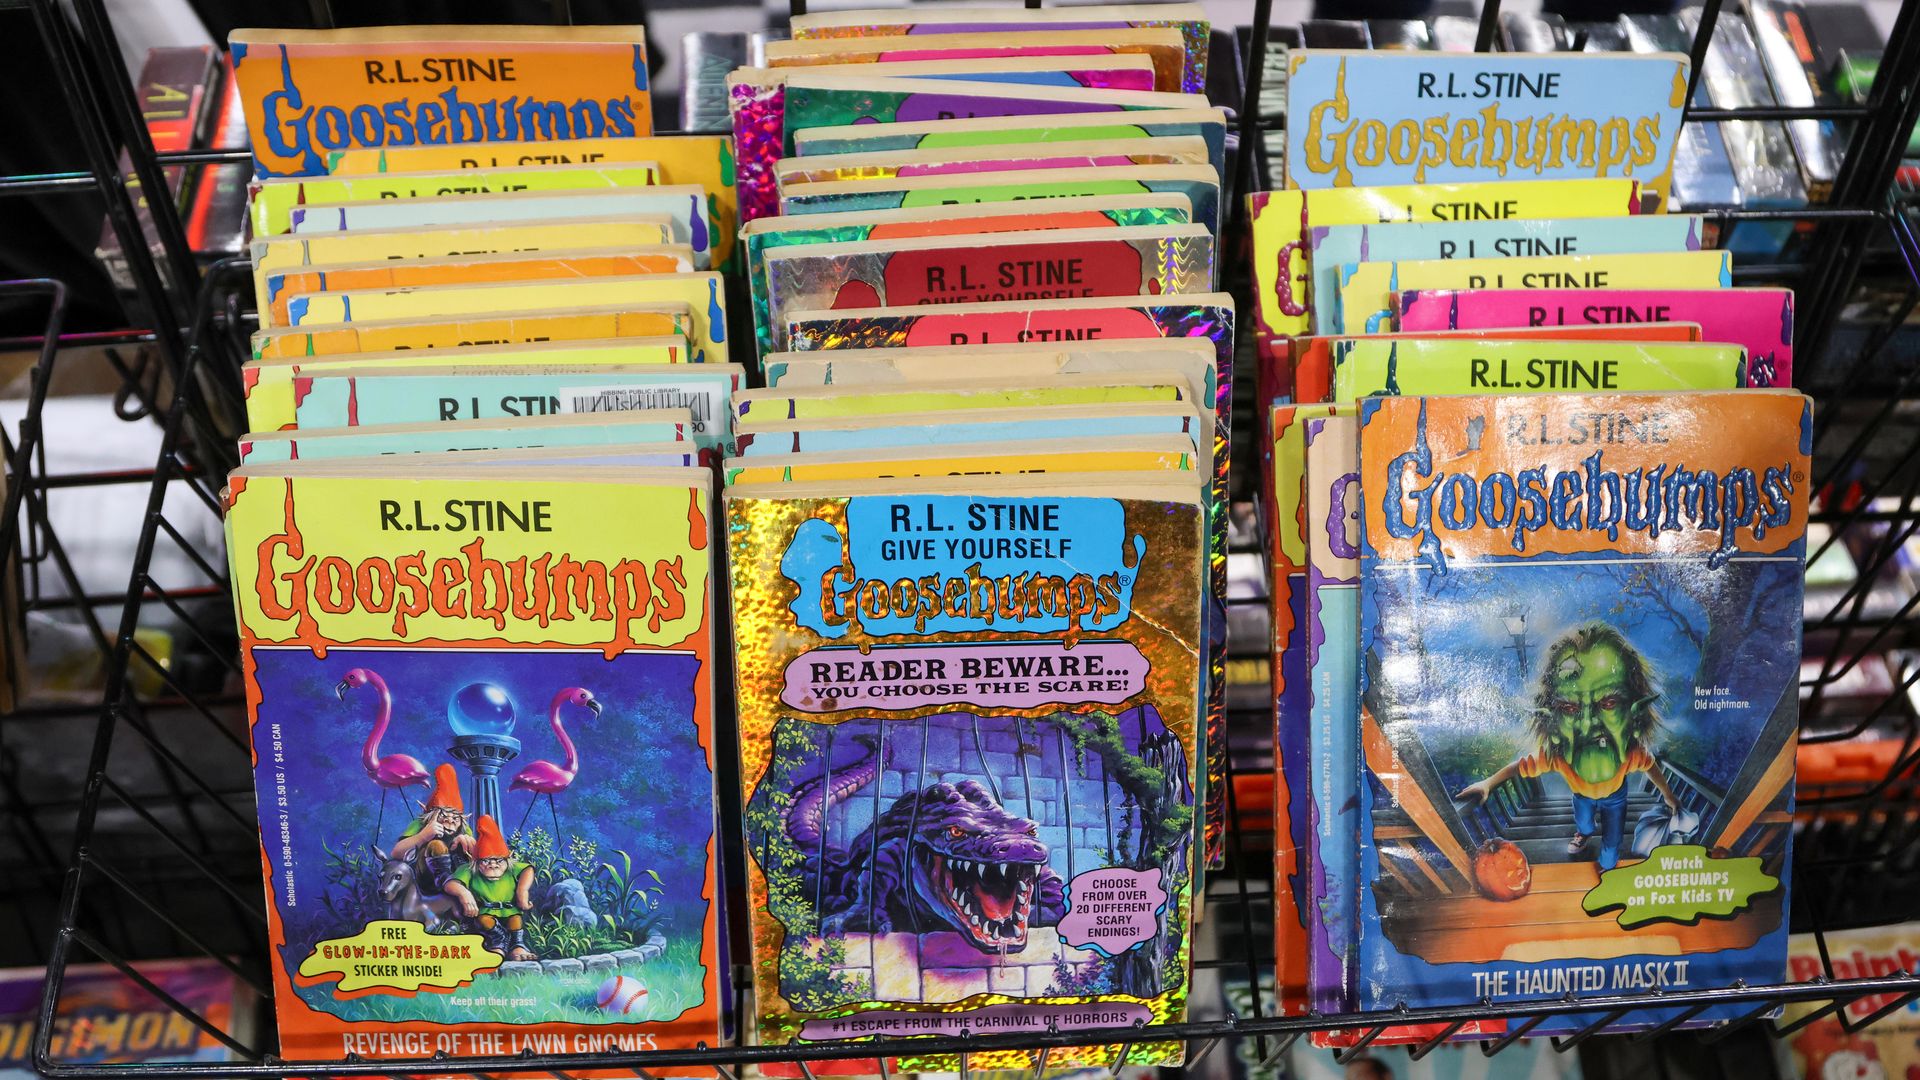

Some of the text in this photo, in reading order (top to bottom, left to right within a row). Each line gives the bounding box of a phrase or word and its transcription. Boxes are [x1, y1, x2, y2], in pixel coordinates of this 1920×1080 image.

[1304, 100, 1660, 186] Goosebumps
[997, 258, 1083, 288] STINE
[890, 504, 1059, 532] R.L. STINE
[1382, 449, 1794, 574] Goosebumps
[881, 538, 1072, 560] GIVE YOURSELF
[255, 532, 687, 658] Goosebumps
[820, 562, 1121, 652] Goosebumps
[810, 655, 1129, 685] READER BEWARE...
[811, 680, 1128, 699] YOU CHOOSE THE SCARE!
[1695, 686, 1731, 696] New face.
[1694, 699, 1751, 712] Old nightmare.
[272, 724, 281, 740] CAN
[273, 741, 284, 763] $4.50
[276, 772, 286, 784] US
[277, 785, 288, 807] $3.50
[280, 814, 292, 867] 0-590-48346-3
[1661, 855, 1703, 870] Watch
[285, 870, 296, 906] Scholastic
[1093, 879, 1137, 889] CHOOSE
[1634, 872, 1729, 889] GOOSEBUMPS
[1082, 891, 1147, 901] FROM OVER
[1628, 889, 1734, 906] on Fox Kids TV
[1076, 903, 1152, 914] 20 DIFFERENT
[1096, 915, 1132, 925] SCARY
[381, 927, 407, 939] FREE
[1088, 927, 1140, 937] ENDINGS!
[323, 944, 471, 959] GLOW-IN-THE-DARK
[354, 965, 442, 977] STICKER INSIDE!
[1472, 960, 1689, 997] THE HAUNTED MASK II
[450, 996, 537, 1008] Keep off their grass!
[832, 1012, 1128, 1033] #1 ESCAPE FROM THE CARNIVAL OF HORRORS
[343, 1032, 429, 1055] REVENGE
[436, 1032, 462, 1055] OF
[468, 1033, 507, 1054] THE
[511, 1033, 566, 1054] LAWN
